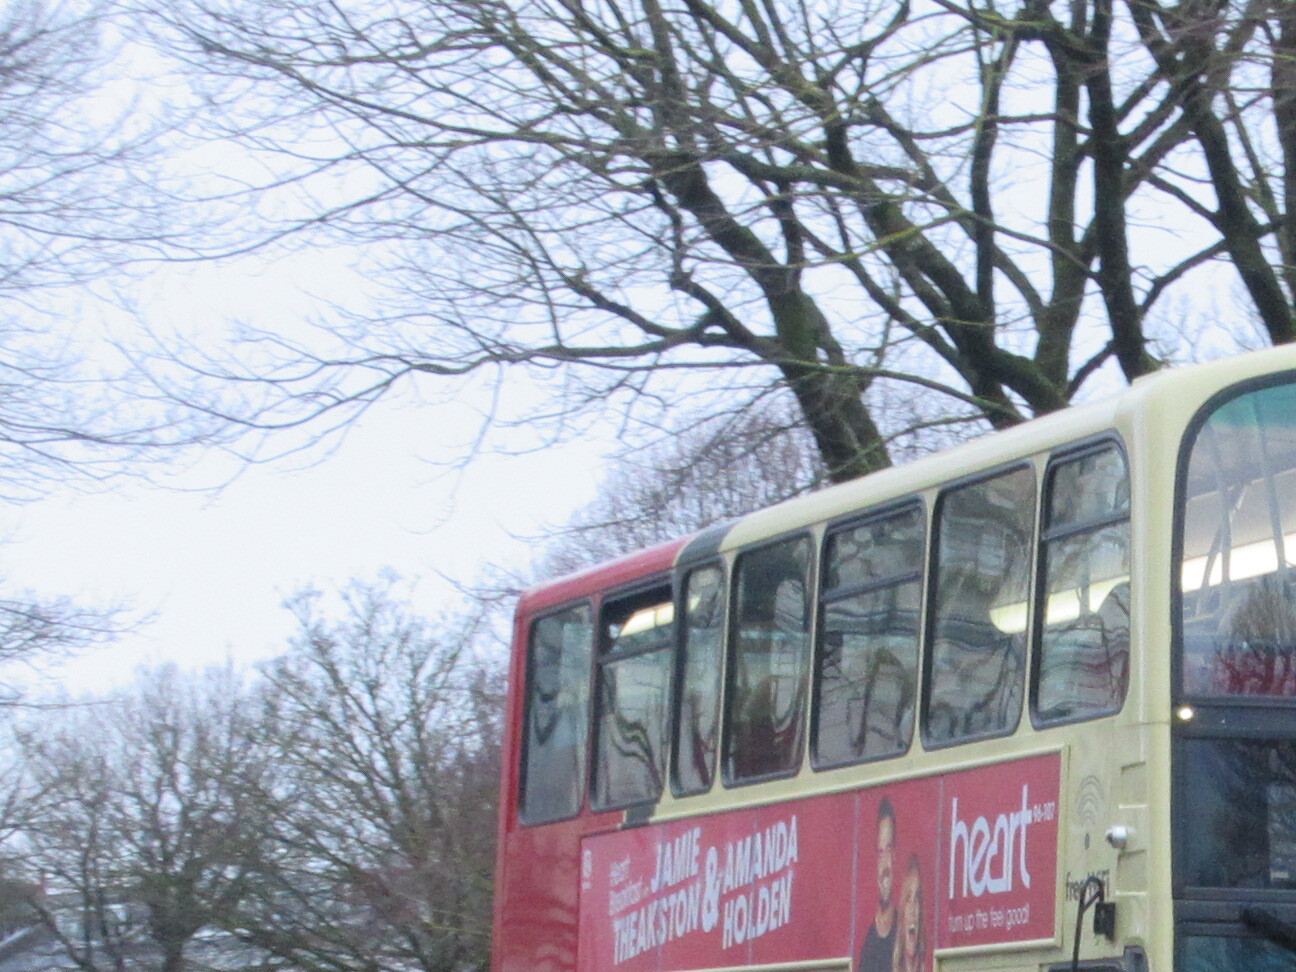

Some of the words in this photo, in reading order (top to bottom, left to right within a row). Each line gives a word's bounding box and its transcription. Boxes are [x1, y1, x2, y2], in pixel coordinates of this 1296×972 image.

[651, 827, 701, 893] JAMIE
[722, 814, 799, 894] AMANDA
[949, 784, 1033, 899] heart
[612, 878, 702, 966] THEAKSTON
[702, 846, 722, 933] &
[722, 869, 794, 950] HOLDEN
